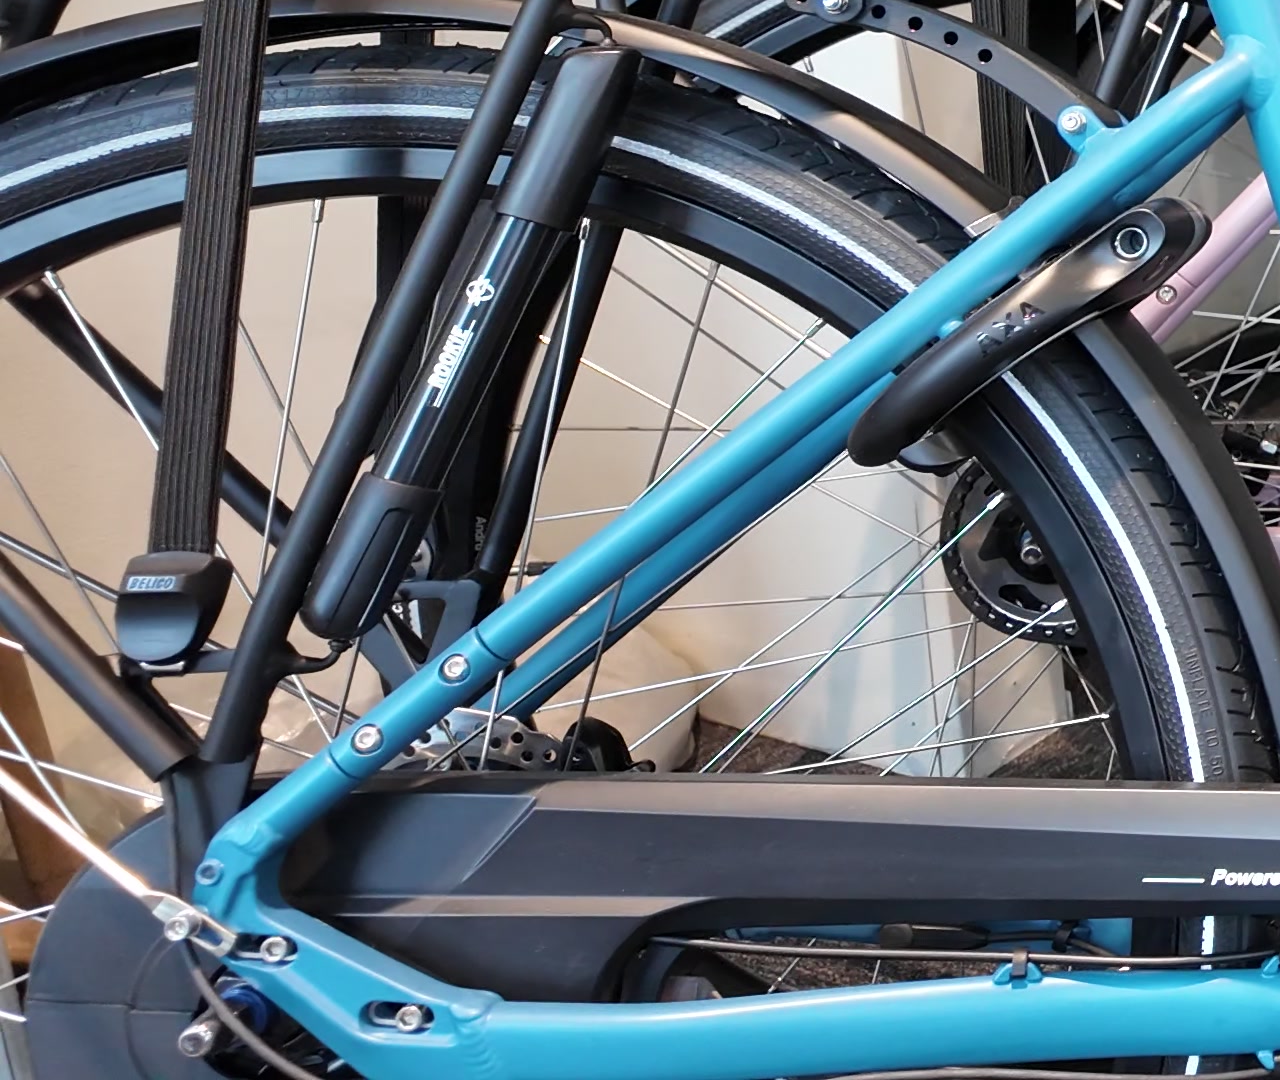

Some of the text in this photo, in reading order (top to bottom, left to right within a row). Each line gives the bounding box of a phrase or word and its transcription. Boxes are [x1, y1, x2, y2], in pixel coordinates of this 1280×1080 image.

[427, 324, 472, 389] ROOKIE
[976, 301, 1047, 358] AXA
[128, 577, 174, 590] BELICO
